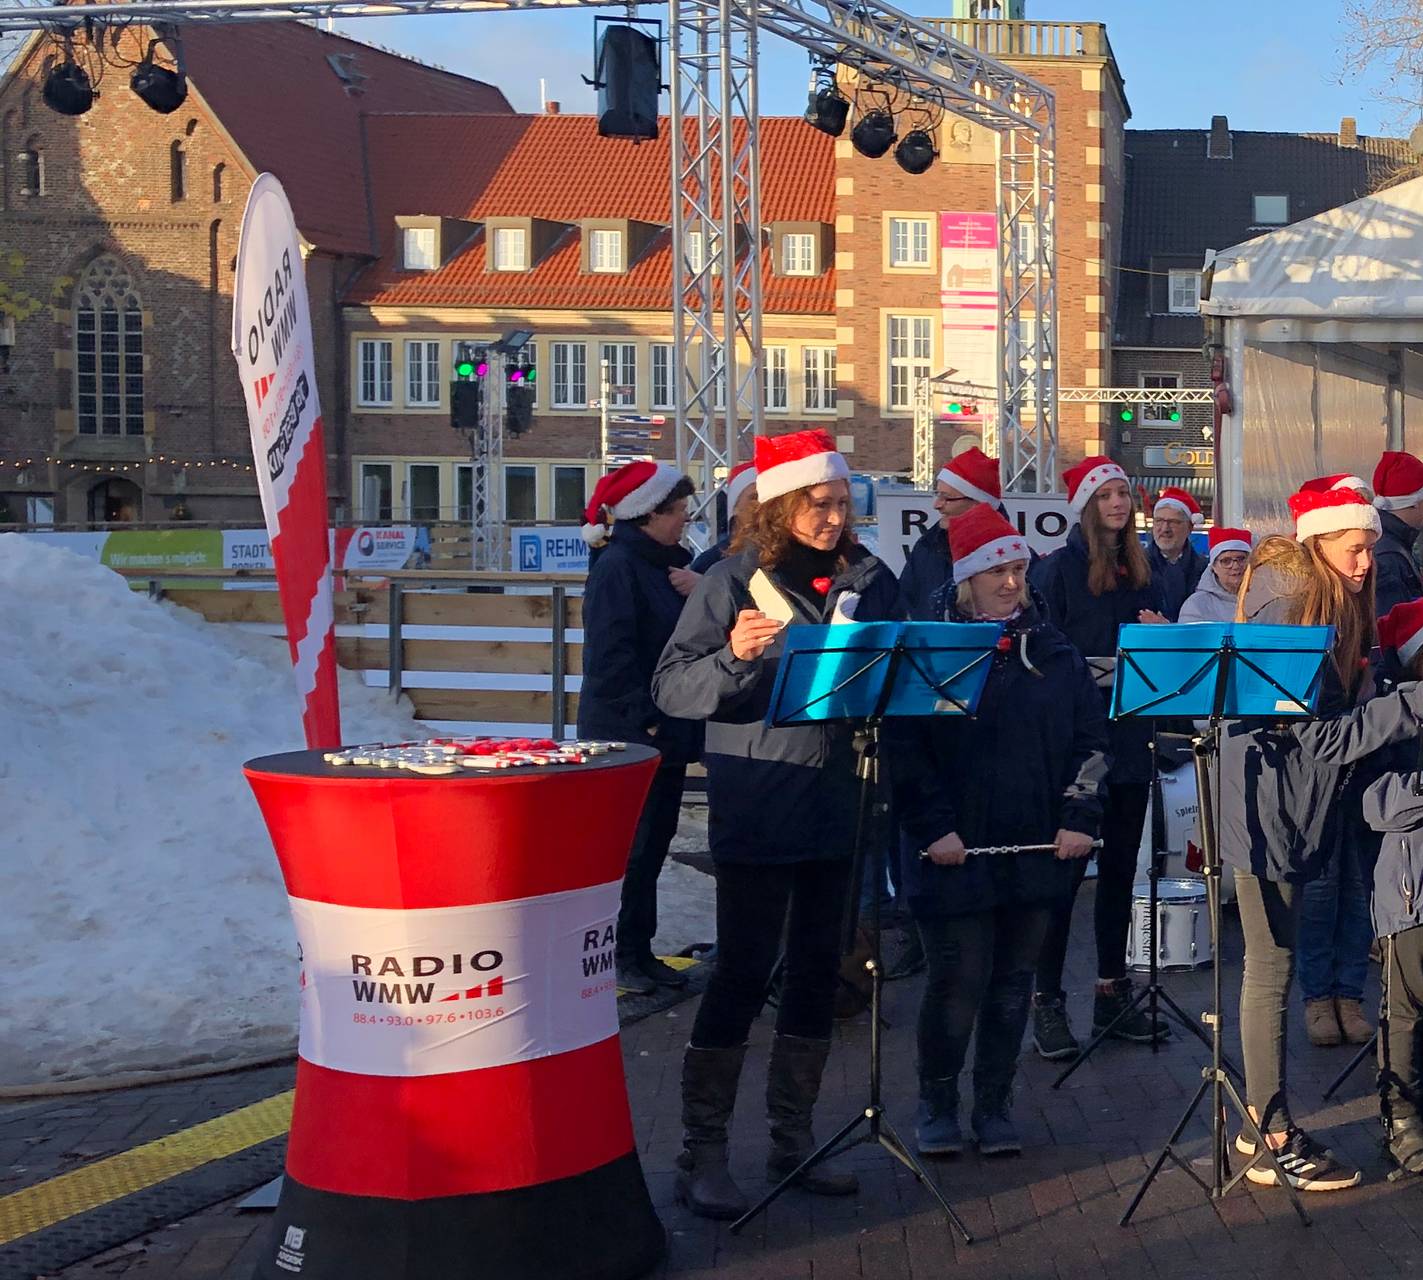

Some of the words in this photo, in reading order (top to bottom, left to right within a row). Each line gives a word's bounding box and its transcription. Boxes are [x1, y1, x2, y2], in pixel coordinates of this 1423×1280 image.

[901, 510, 1068, 537] RIO
[232, 544, 266, 559] STADT
[546, 539, 590, 557] REHM
[351, 950, 504, 977] RADIO
[353, 979, 435, 1005] WMW
[352, 1013, 377, 1025] 88.4
[386, 1016, 414, 1026] 93.0
[426, 1012, 457, 1025] 97.6
[467, 1006, 505, 1021] 103.6
